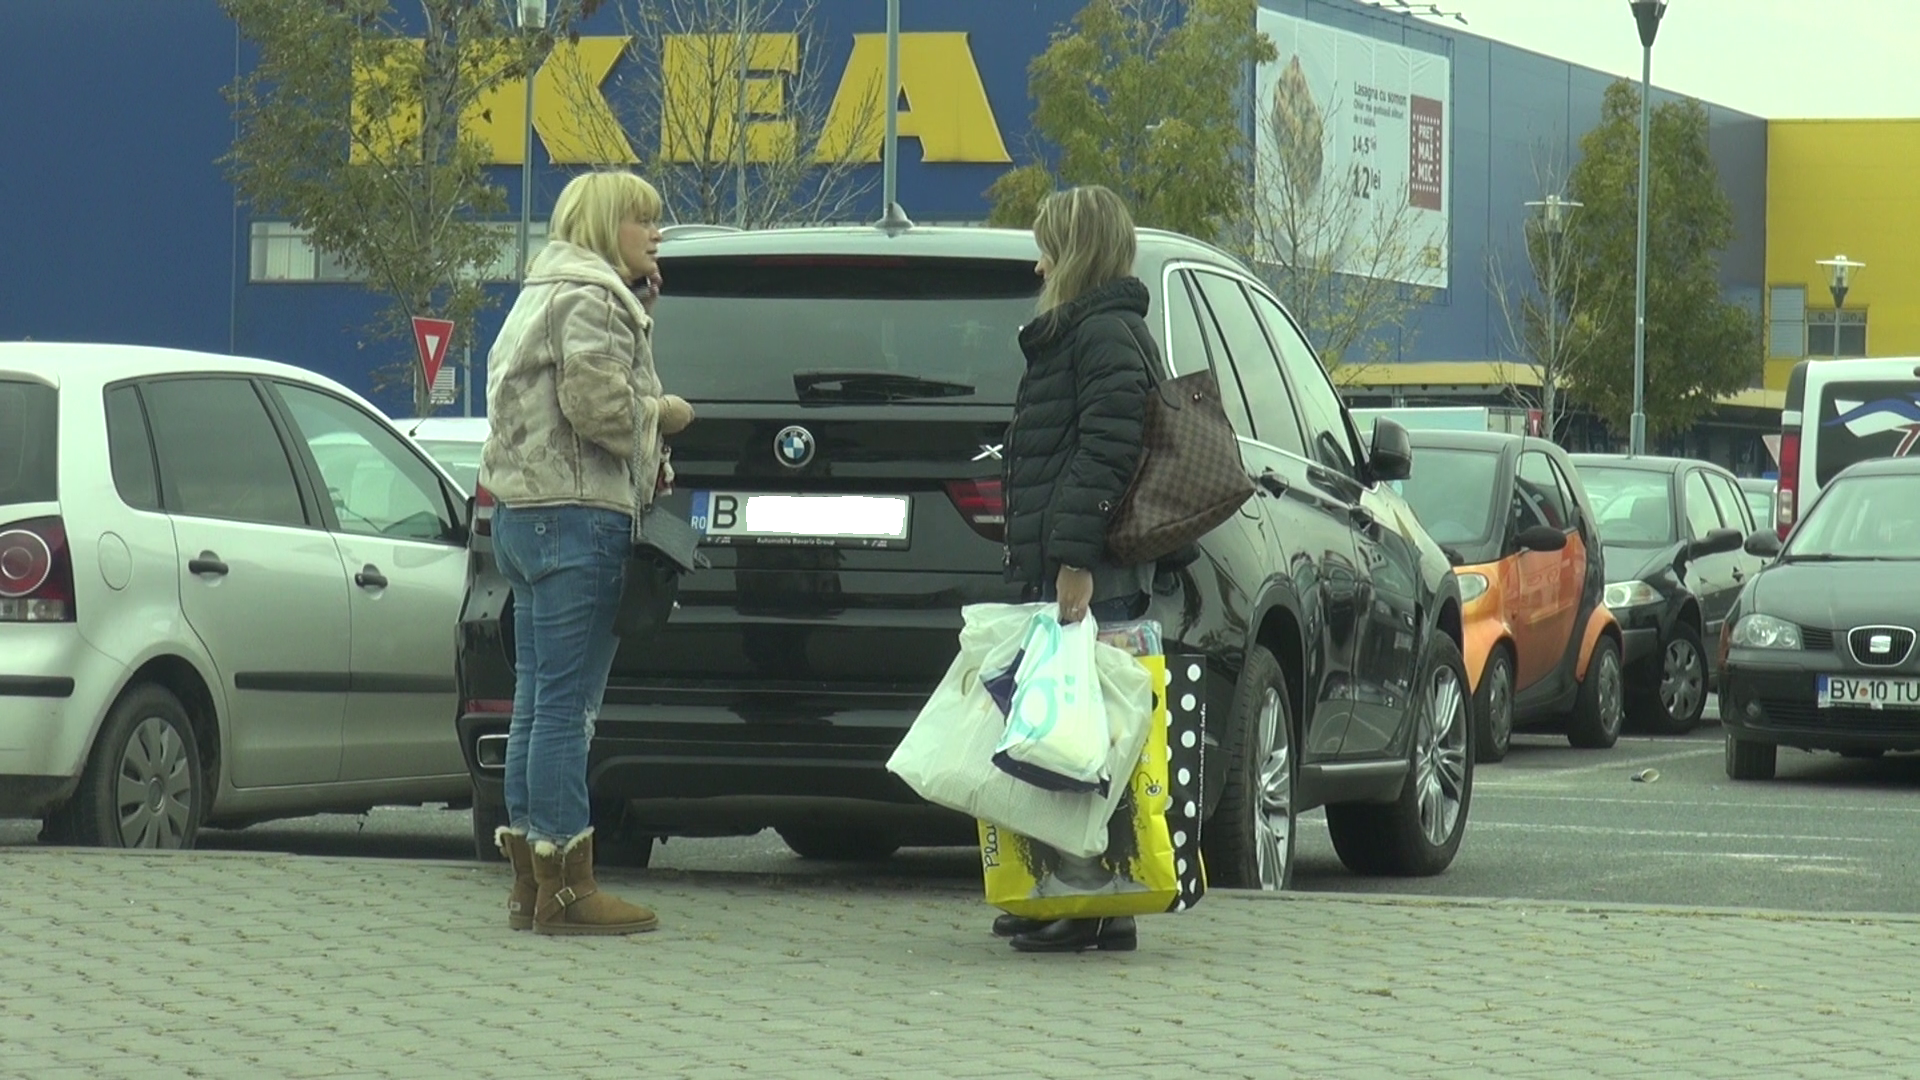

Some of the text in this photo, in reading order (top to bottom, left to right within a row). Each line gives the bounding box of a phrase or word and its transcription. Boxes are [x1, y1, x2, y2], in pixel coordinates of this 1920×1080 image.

[349, 31, 1012, 164] IKEA
[1418, 143, 1434, 161] MAI
[1353, 163, 1381, 199] 12 lei
[1417, 163, 1434, 183] MIC
[712, 495, 738, 529] B
[691, 516, 706, 530] RO
[816, 538, 836, 546] Group
[1830, 679, 1920, 702] BV 10 TU
